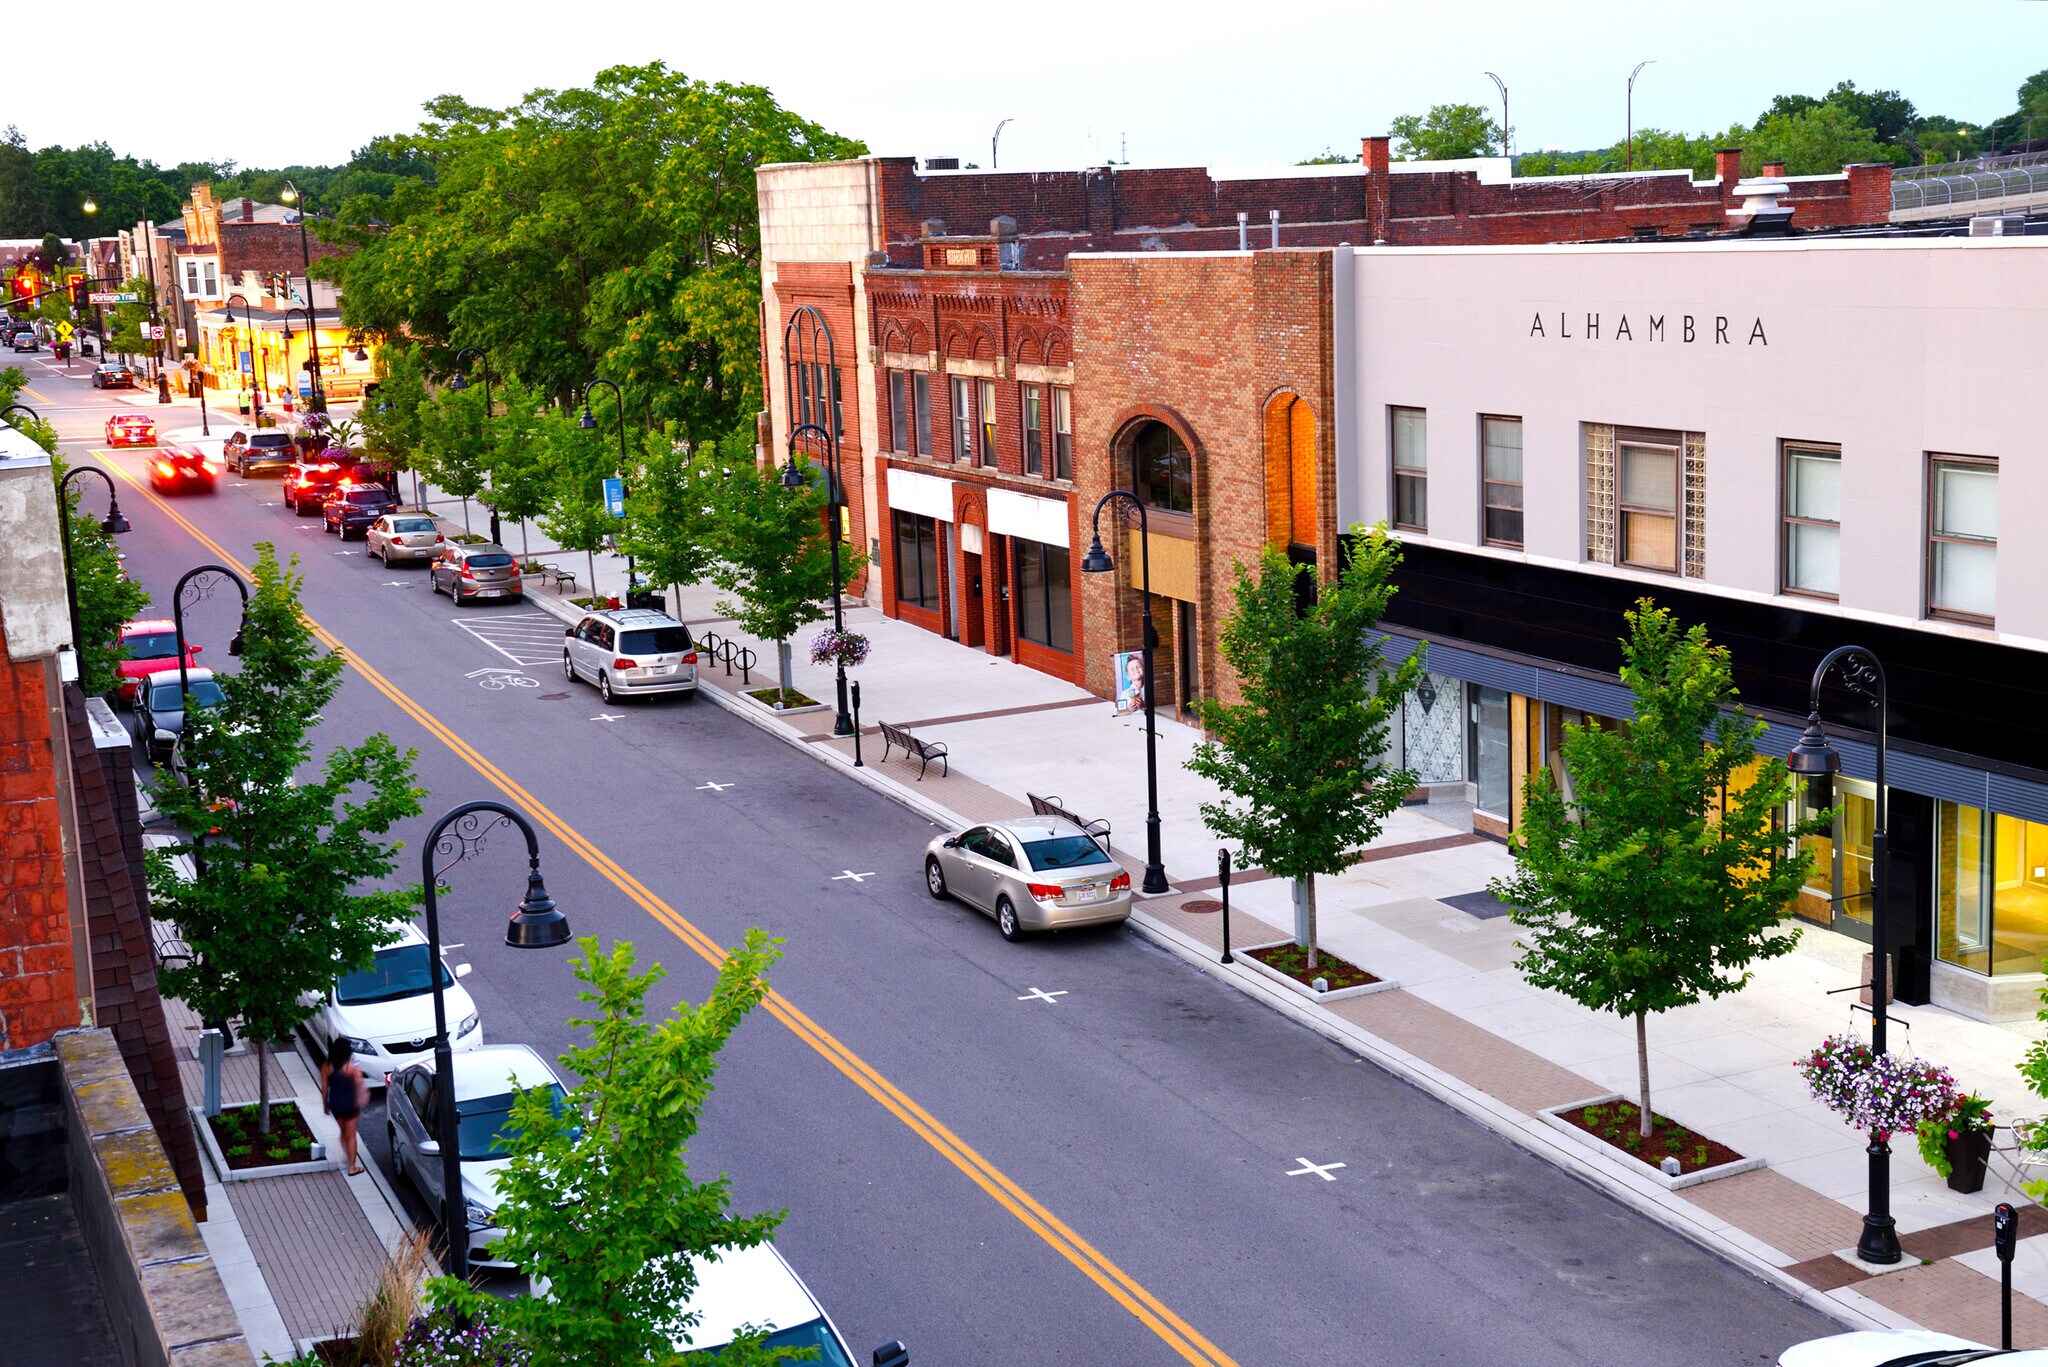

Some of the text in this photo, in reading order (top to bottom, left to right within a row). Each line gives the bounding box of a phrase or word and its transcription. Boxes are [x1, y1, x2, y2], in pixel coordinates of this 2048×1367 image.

[91, 292, 138, 302] Portage Trail
[1530, 311, 1768, 346] ALHAMBRA
